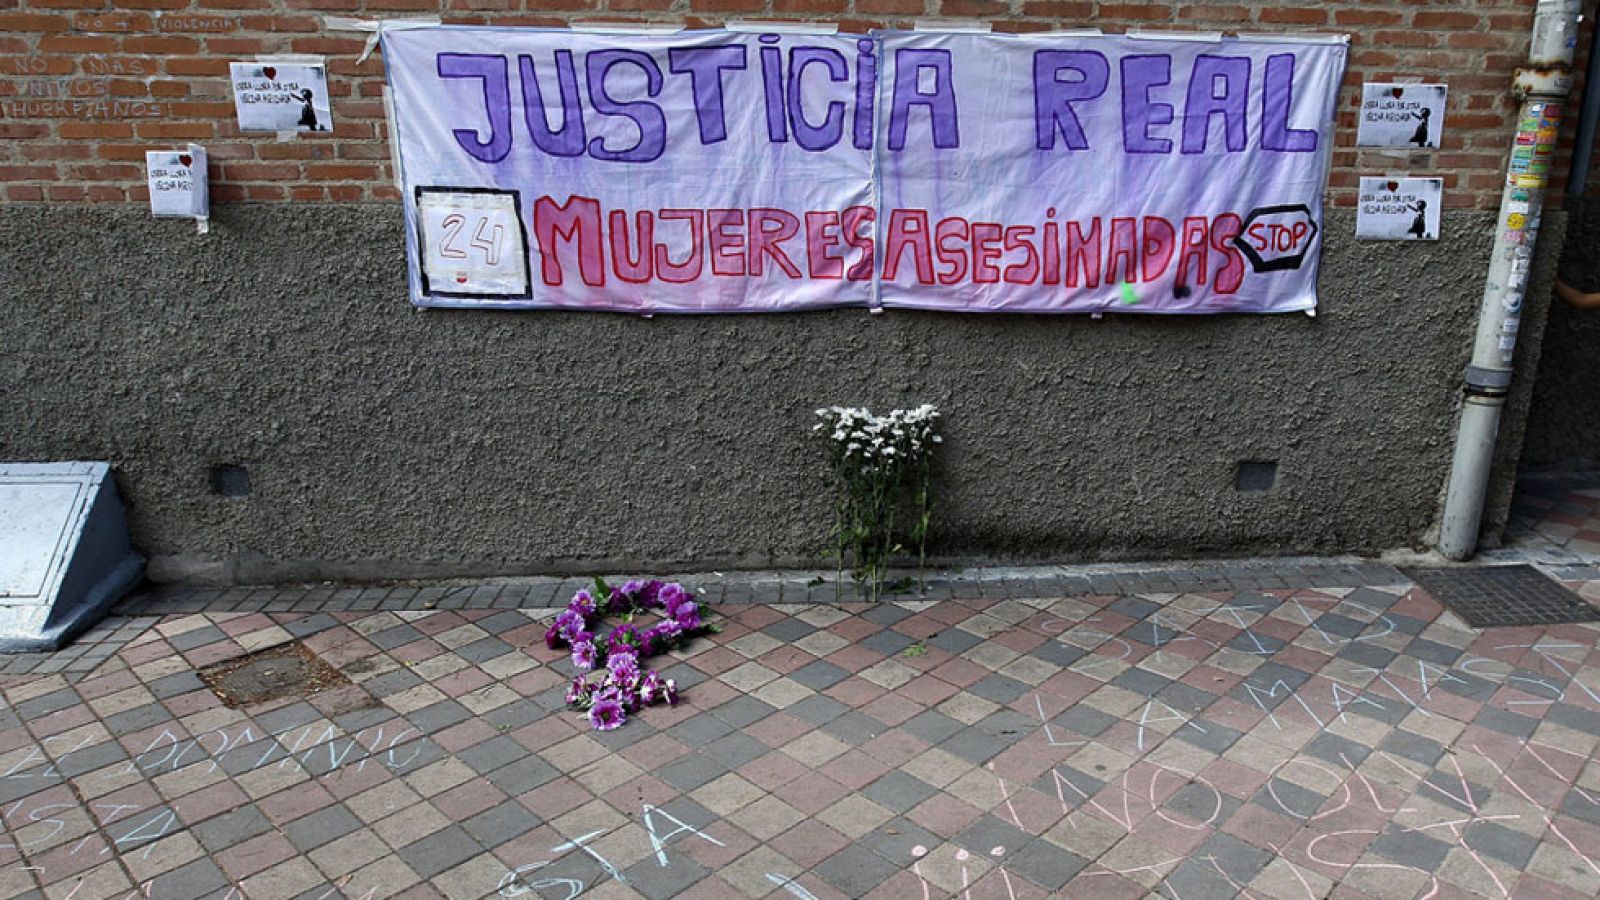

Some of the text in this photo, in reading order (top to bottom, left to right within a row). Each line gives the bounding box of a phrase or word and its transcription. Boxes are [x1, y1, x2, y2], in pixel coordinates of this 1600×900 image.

[1033, 49, 1318, 154] REAL
[439, 213, 504, 266] 24
[534, 194, 1245, 294] MUJERES ASESINADAS
[1248, 220, 1307, 252] STOP
